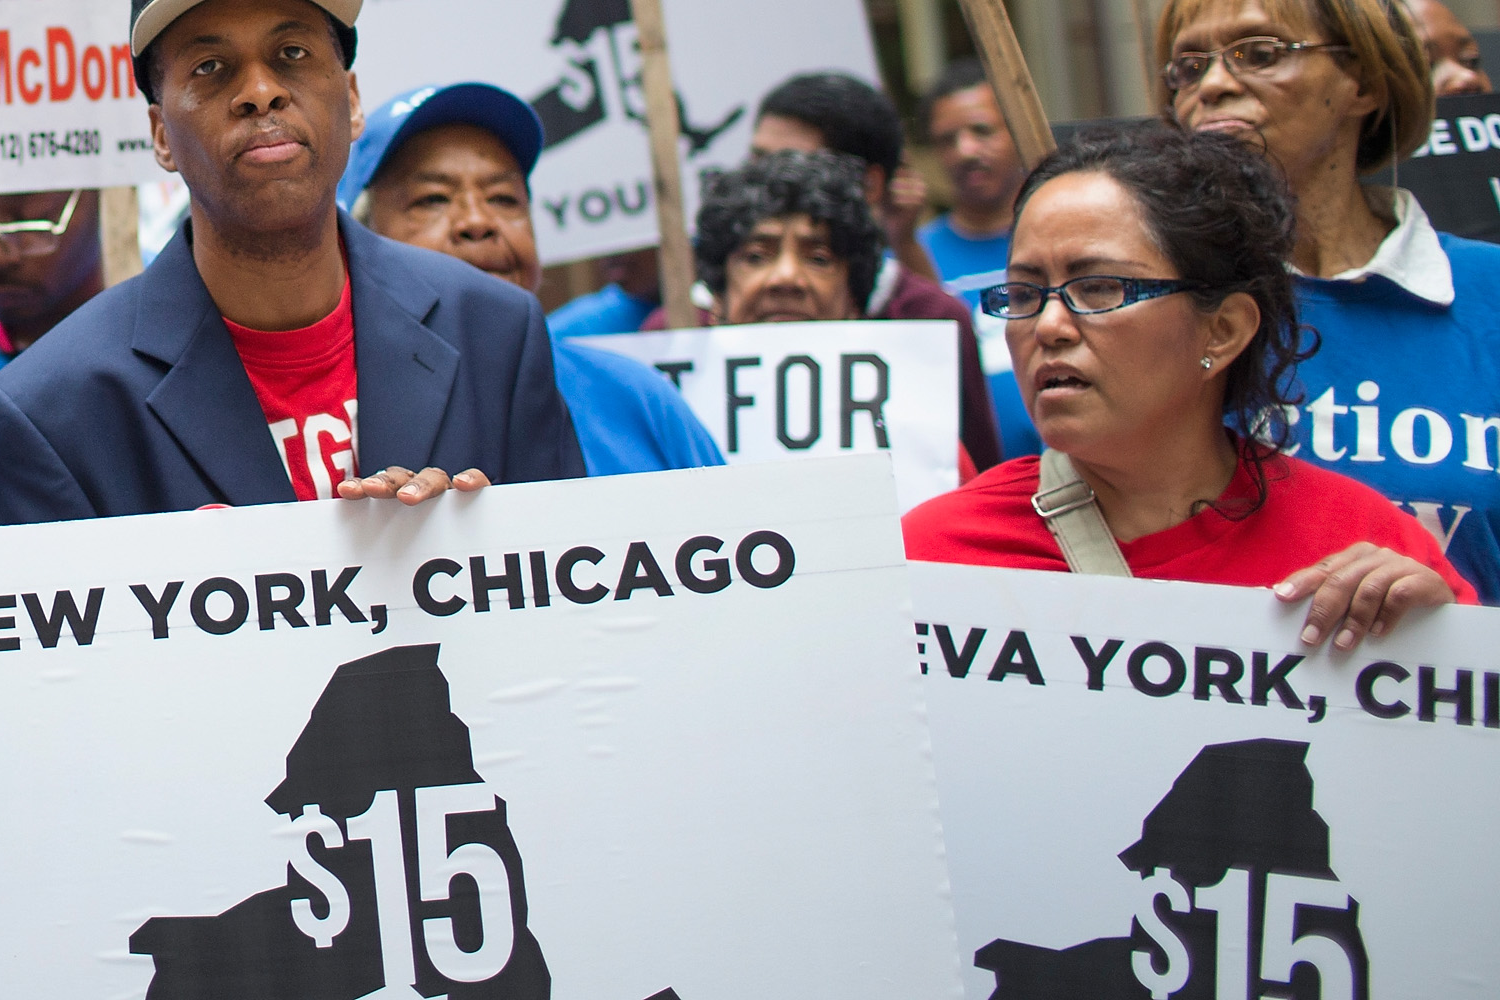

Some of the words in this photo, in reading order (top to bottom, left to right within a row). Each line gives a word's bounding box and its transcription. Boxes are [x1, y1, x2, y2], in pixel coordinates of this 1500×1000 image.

[545, 182, 649, 231] YOU
[726, 353, 890, 453] FOR
[128, 565, 388, 636] YORK,
[411, 529, 796, 618] CHICAGO
[1069, 634, 1327, 724] YORK,
[1354, 660, 1500, 730] CHI
[288, 782, 514, 990] $15
[1130, 866, 1358, 1000] $15
